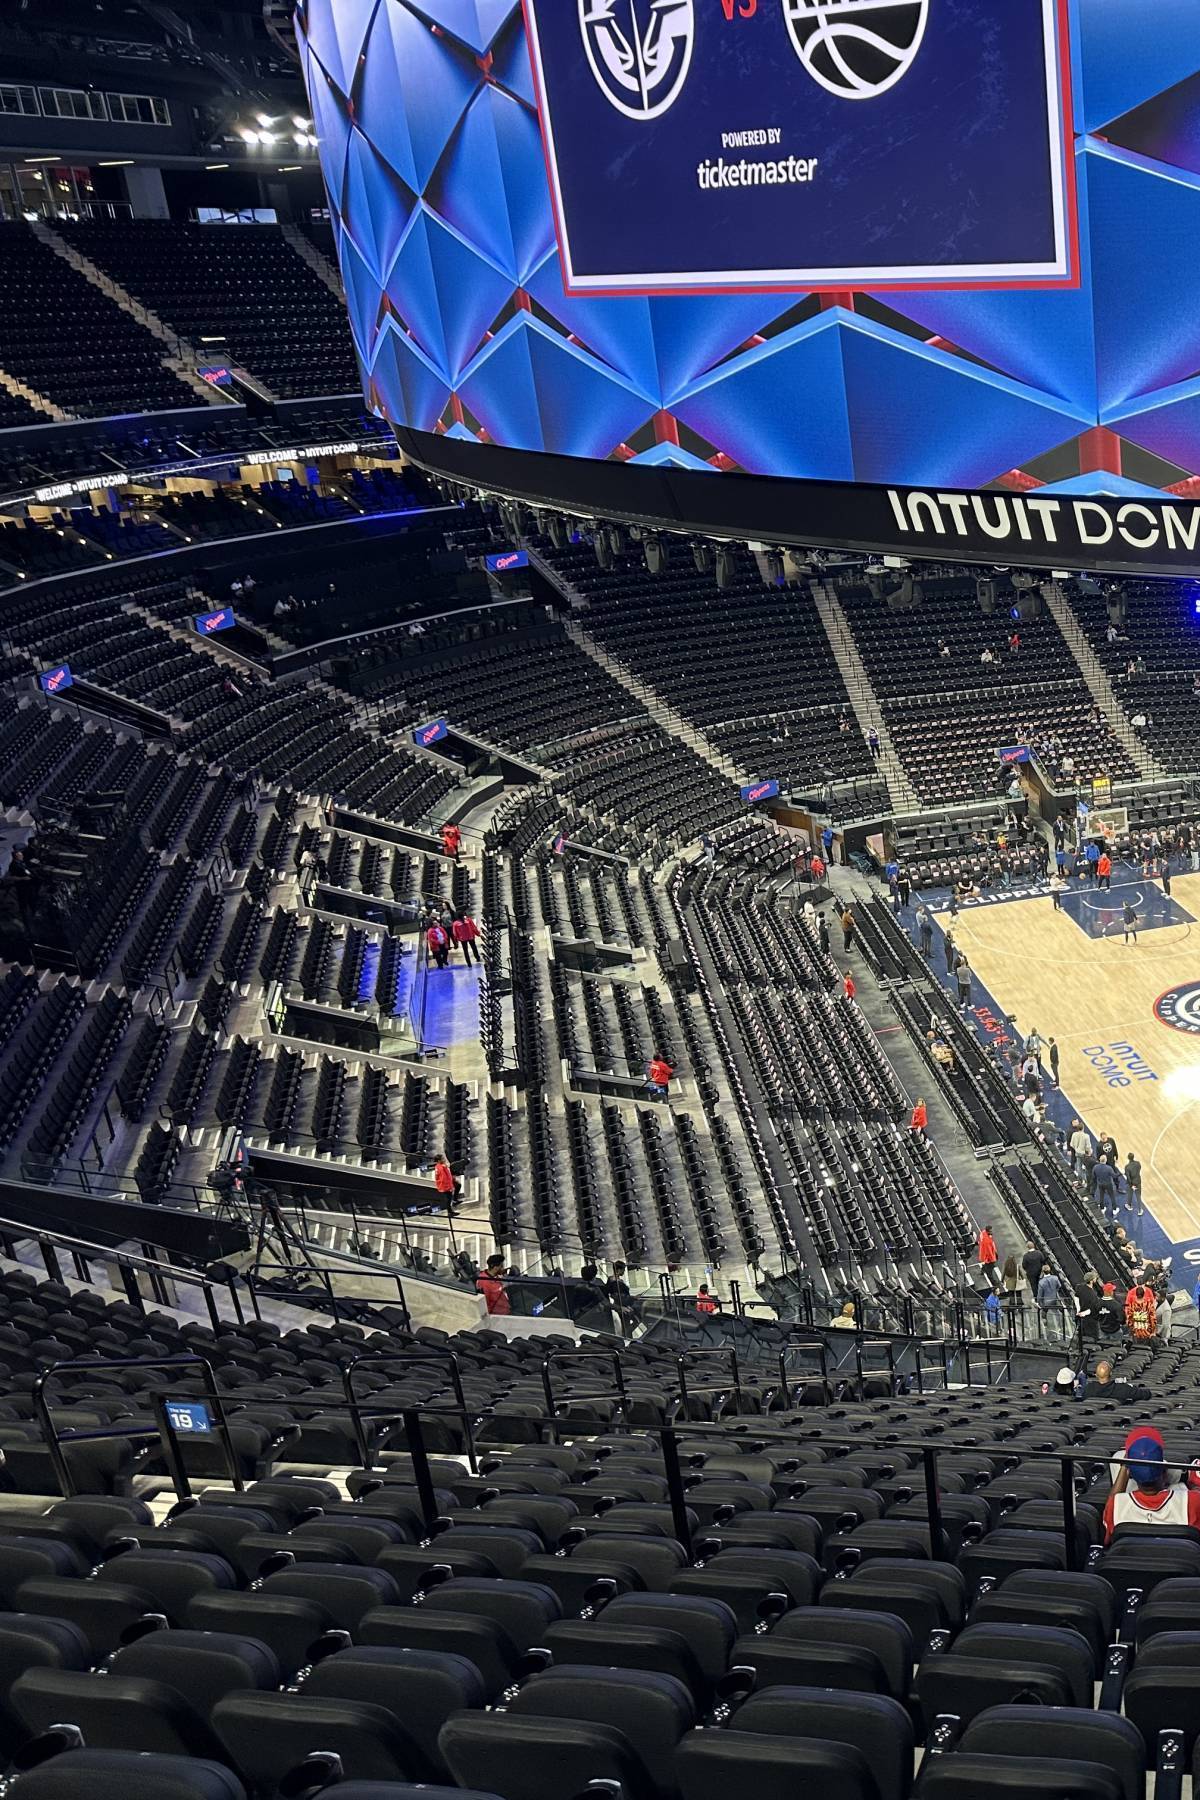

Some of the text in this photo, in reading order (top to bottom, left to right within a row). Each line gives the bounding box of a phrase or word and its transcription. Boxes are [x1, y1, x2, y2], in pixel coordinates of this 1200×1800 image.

[721, 128, 781, 148] POWERED BY
[697, 155, 818, 189] ticketmaster
[248, 450, 298, 464] WELCOME
[36, 483, 73, 501] WELCOME
[170, 1413, 193, 1428] 19
